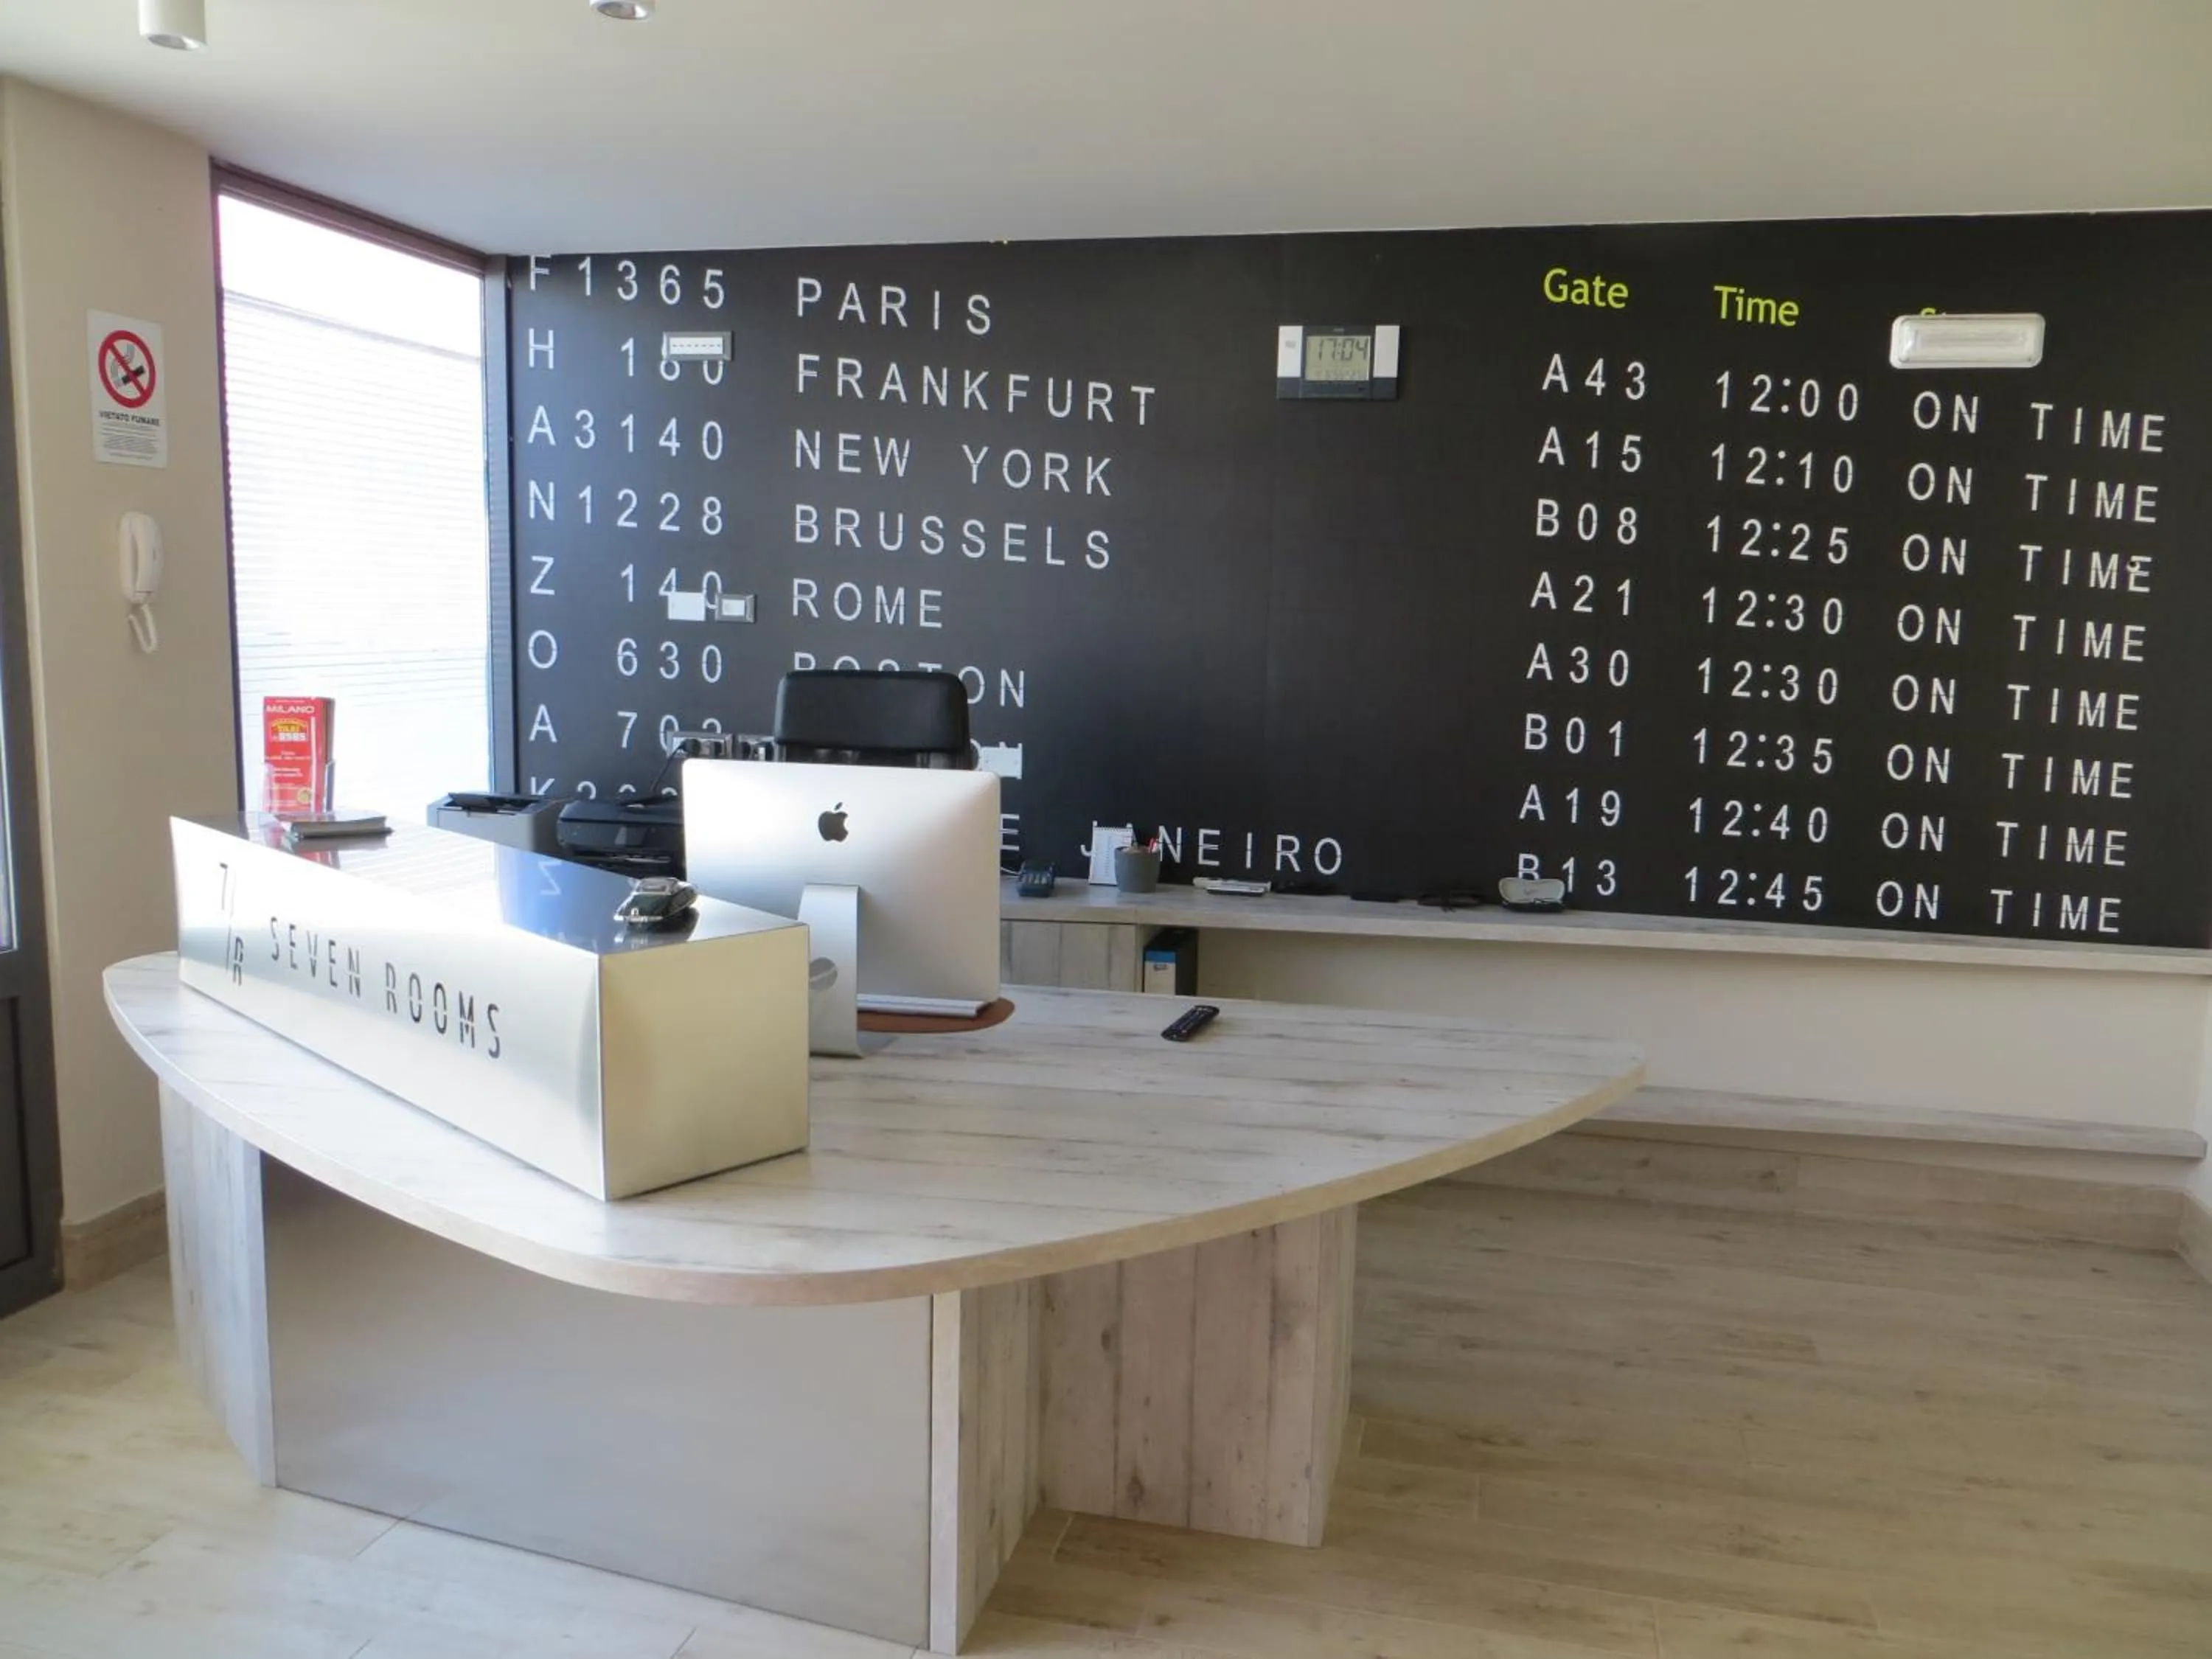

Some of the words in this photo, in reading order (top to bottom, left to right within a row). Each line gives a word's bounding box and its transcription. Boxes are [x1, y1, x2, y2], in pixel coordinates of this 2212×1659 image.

[797, 277, 990, 335] PARIS
[1543, 268, 1629, 309] Gate
[1713, 285, 1800, 327] Time
[529, 328, 554, 369] H
[798, 354, 1155, 425] FRANKFURT
[1543, 354, 1645, 400] A43
[1717, 371, 1858, 422] 12:00
[1913, 391, 1978, 434] ON
[2031, 403, 2165, 452] TIME
[796, 429, 910, 477] NEW
[962, 445, 1111, 496] YORK
[1538, 426, 1641, 472] A15
[1711, 443, 1854, 493] 12:10
[1907, 463, 1972, 504] ON
[2025, 473, 2158, 523] TIME
[796, 504, 1109, 570] BRUSSELS
[1536, 498, 1638, 546] B08
[1707, 515, 1848, 565] 12:25
[530, 556, 554, 595] Z
[1902, 534, 1966, 575] ON
[2019, 544, 2152, 593] TIME
[793, 578, 942, 628] ROME
[1530, 571, 1631, 616] A21
[1703, 587, 1843, 635] 12:30
[1897, 605, 1961, 645] ON
[2013, 614, 2146, 662] TIME
[617, 638, 723, 683] 630
[1526, 643, 1630, 687] A30
[1698, 658, 1837, 706] 12:30
[529, 704, 557, 743] A
[1891, 675, 1955, 714] ON
[2007, 684, 2140, 731] TIME
[1524, 713, 1622, 757] B01
[1694, 728, 1832, 775] 12:35
[1886, 744, 1950, 784] ON
[2001, 753, 2134, 799] TIME
[1519, 784, 1621, 827] A19
[1689, 797, 1828, 844] 12:40
[1081, 821, 1343, 875] NEIRO
[1881, 813, 1945, 852] ON
[1996, 821, 2128, 866] TIME
[1518, 852, 1616, 897] B13
[1685, 866, 1823, 911] 12:45
[1876, 881, 1940, 920] ON
[1991, 889, 2122, 933] TIME
[270, 917, 361, 998] SEVEN
[385, 961, 501, 1059] ROOMS
